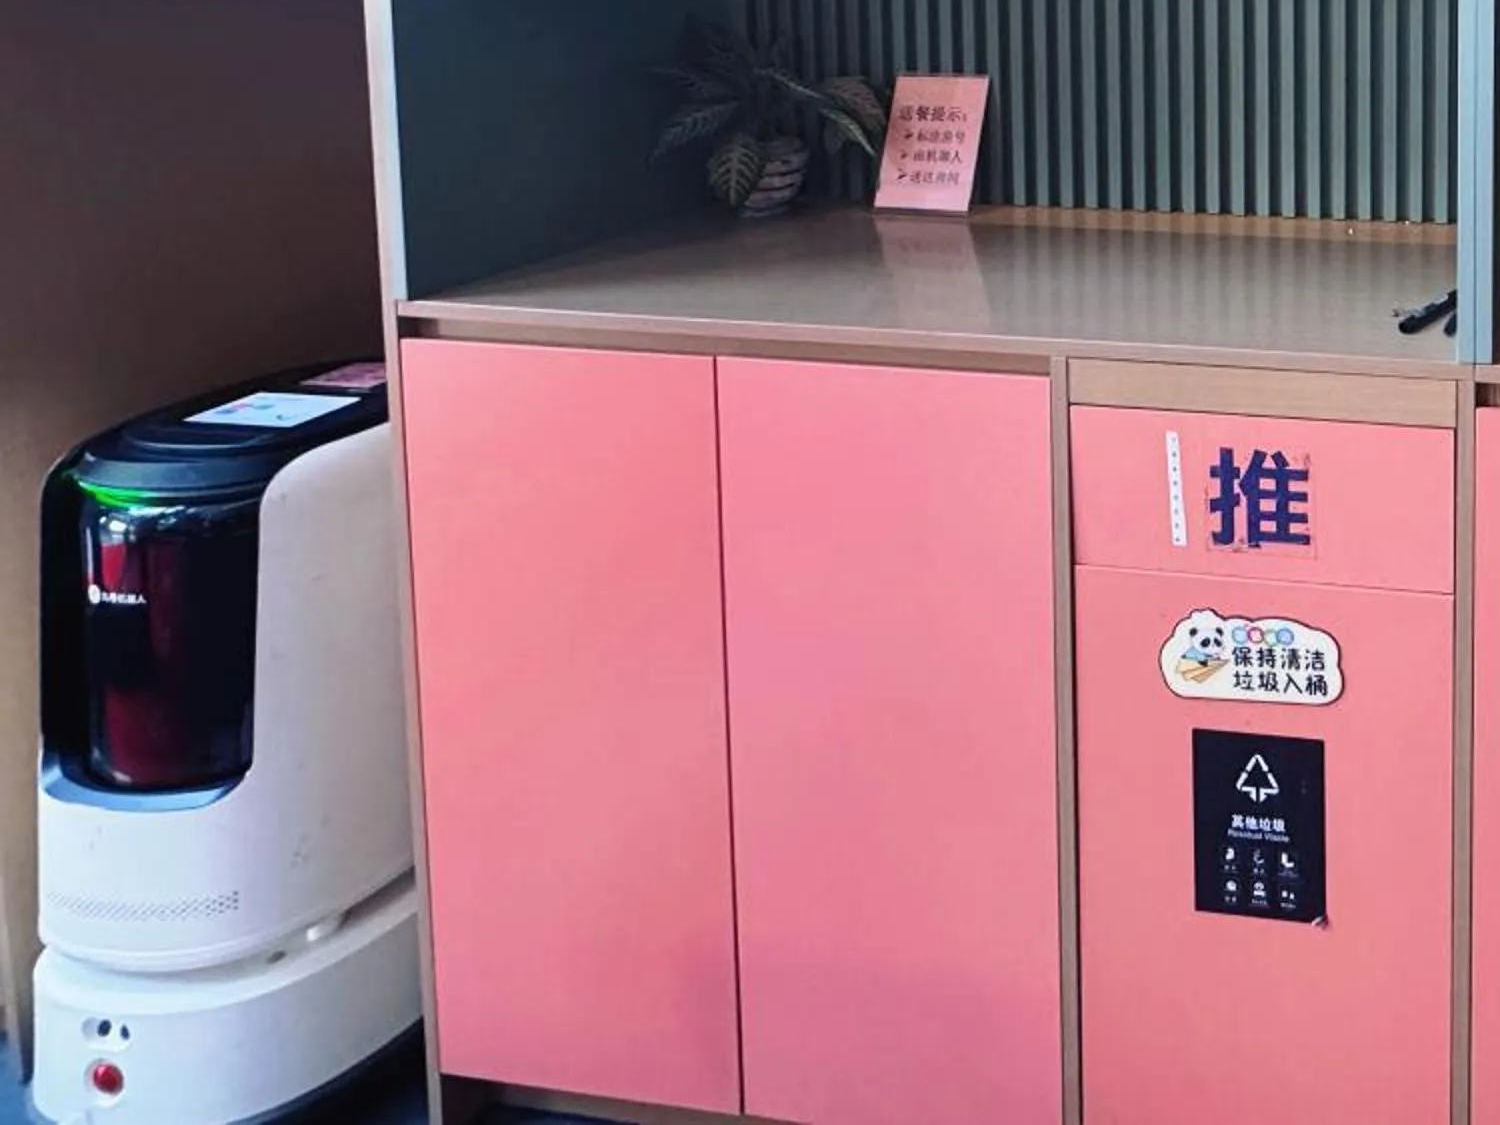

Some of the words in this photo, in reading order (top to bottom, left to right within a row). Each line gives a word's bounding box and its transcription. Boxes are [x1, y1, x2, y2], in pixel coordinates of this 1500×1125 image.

[1209, 446, 1311, 548] 推
[1232, 646, 1325, 671] 保持清洁
[1233, 670, 1328, 696] 垃圾入桶
